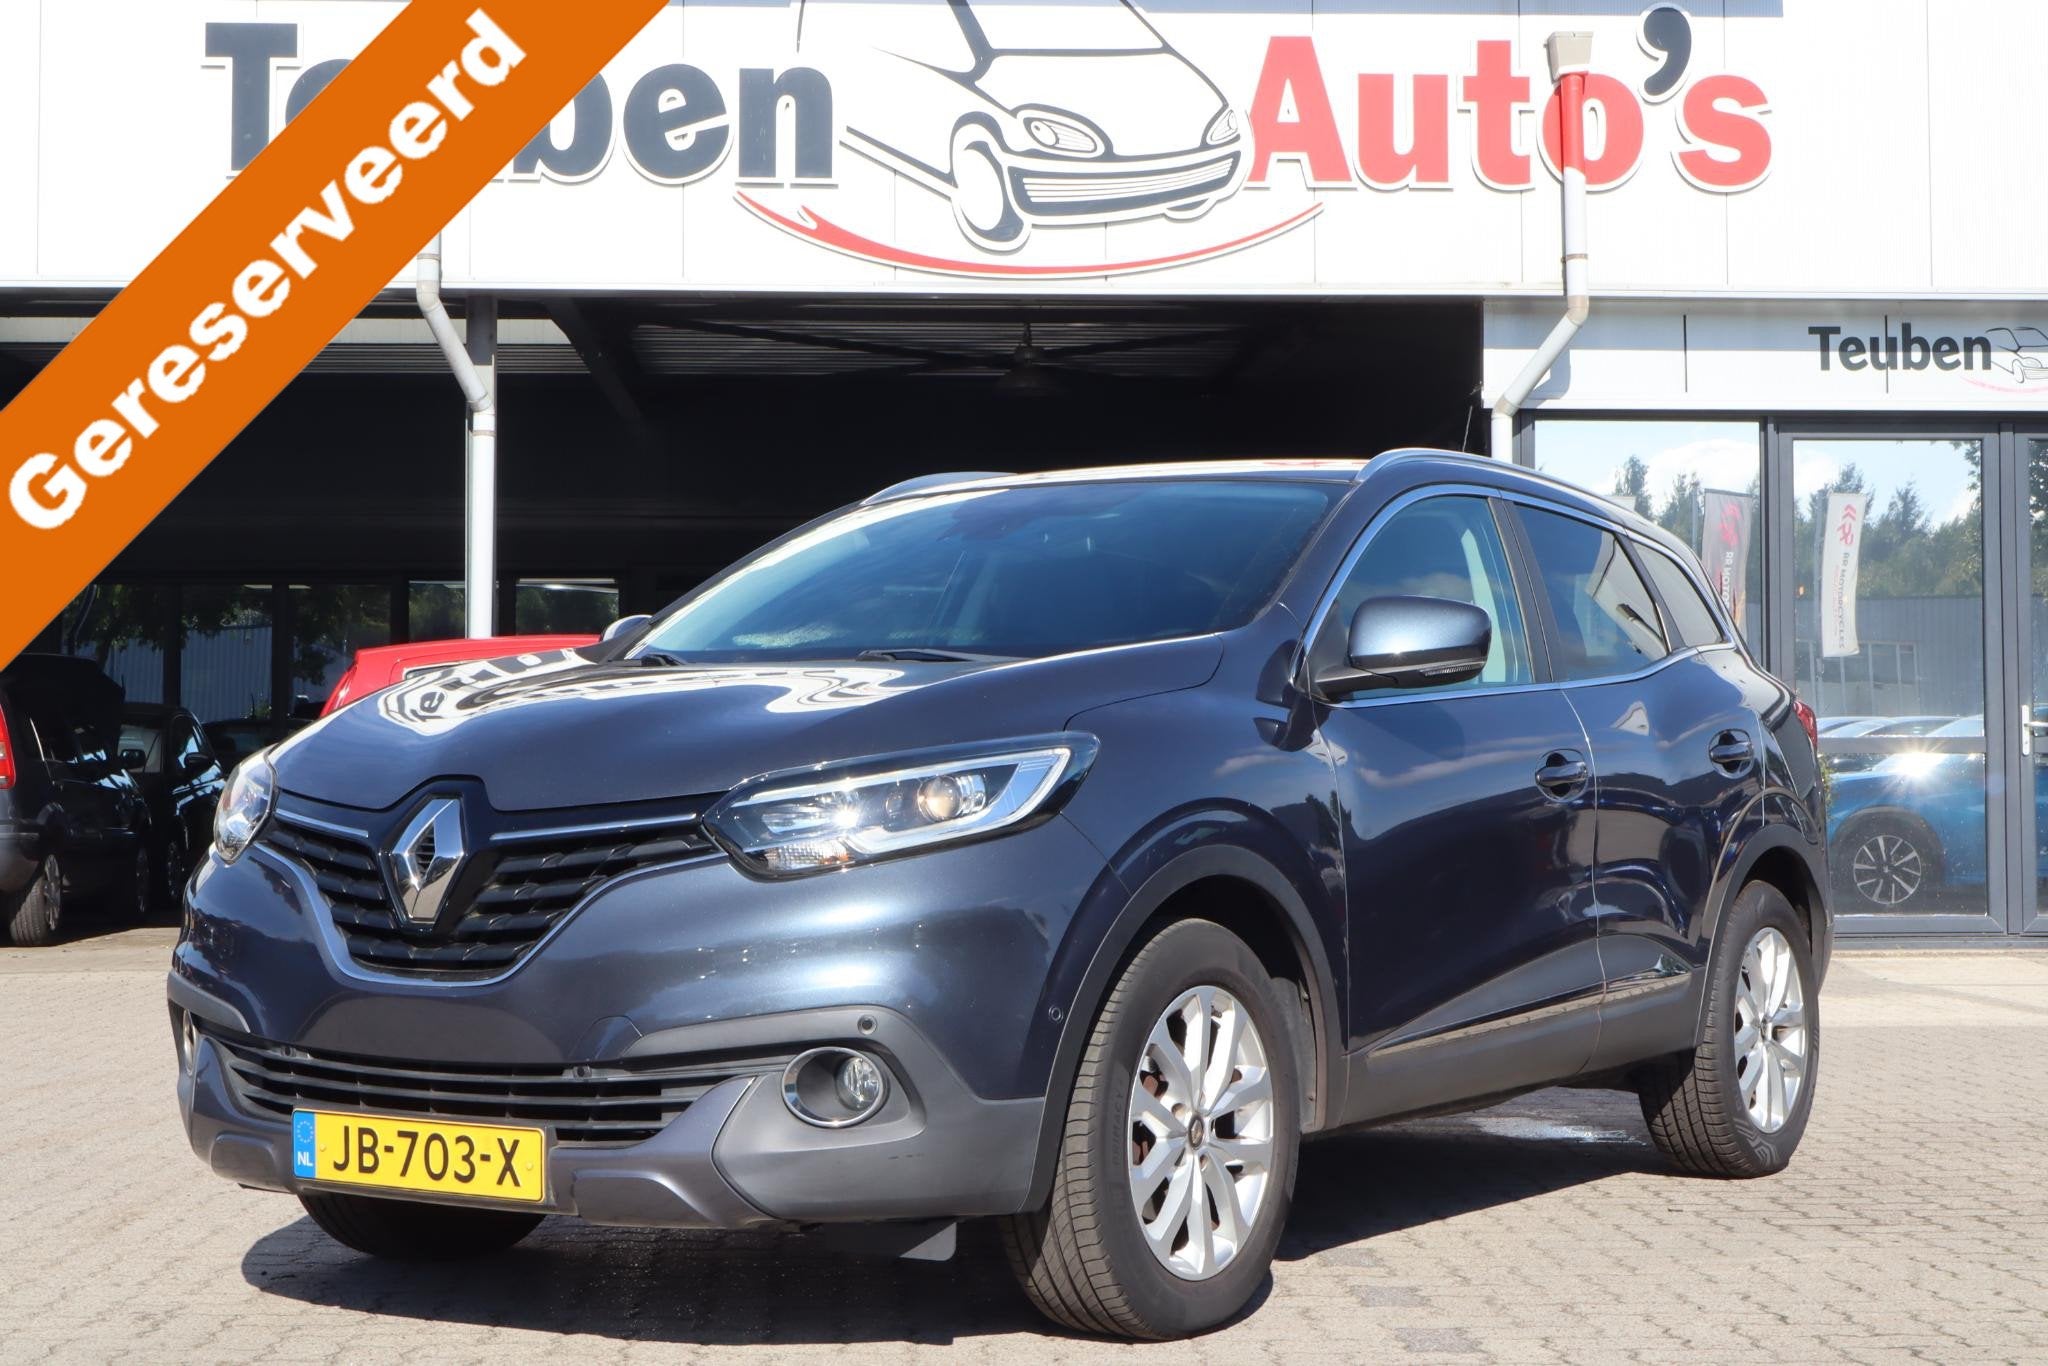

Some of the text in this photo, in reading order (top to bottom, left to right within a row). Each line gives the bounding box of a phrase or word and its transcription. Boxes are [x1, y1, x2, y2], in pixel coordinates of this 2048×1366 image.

[1247, 4, 1773, 191] Auto's
[1808, 322, 1992, 371] Teuben
[1837, 570, 1849, 649] MOTORCYCLES
[297, 1125, 521, 1187] NL JB-703-X
